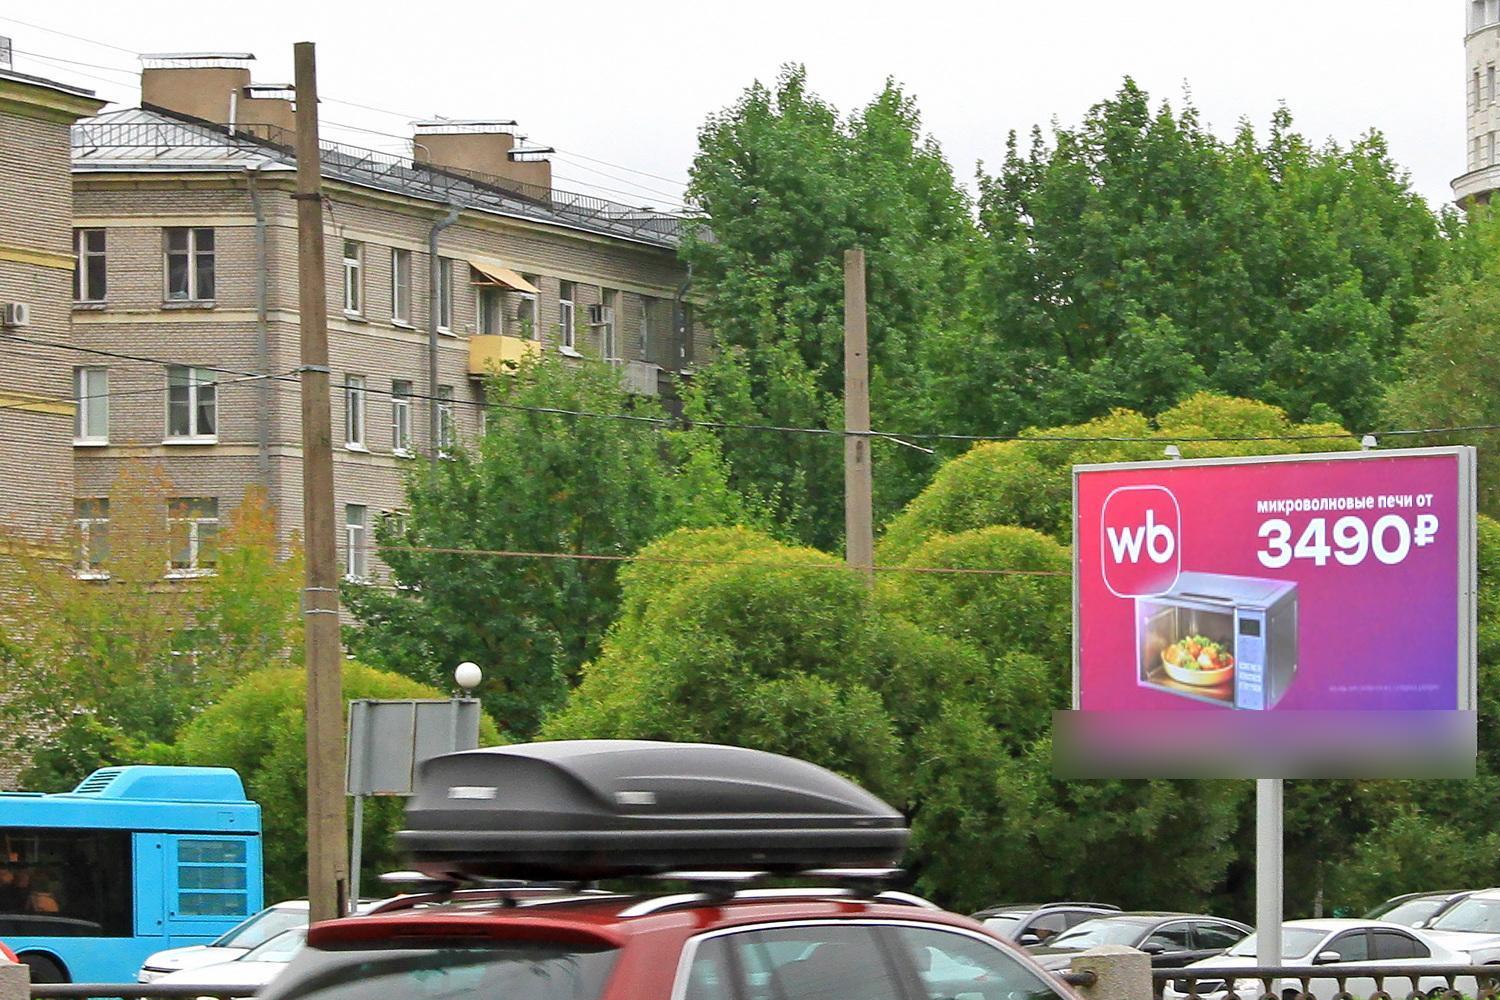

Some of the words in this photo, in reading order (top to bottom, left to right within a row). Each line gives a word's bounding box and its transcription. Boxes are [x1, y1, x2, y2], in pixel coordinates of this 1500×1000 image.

[1257, 495, 1374, 516] микроволновые
[1378, 494, 1413, 508] печи
[1416, 494, 1433, 507] от
[1106, 509, 1175, 564] wb
